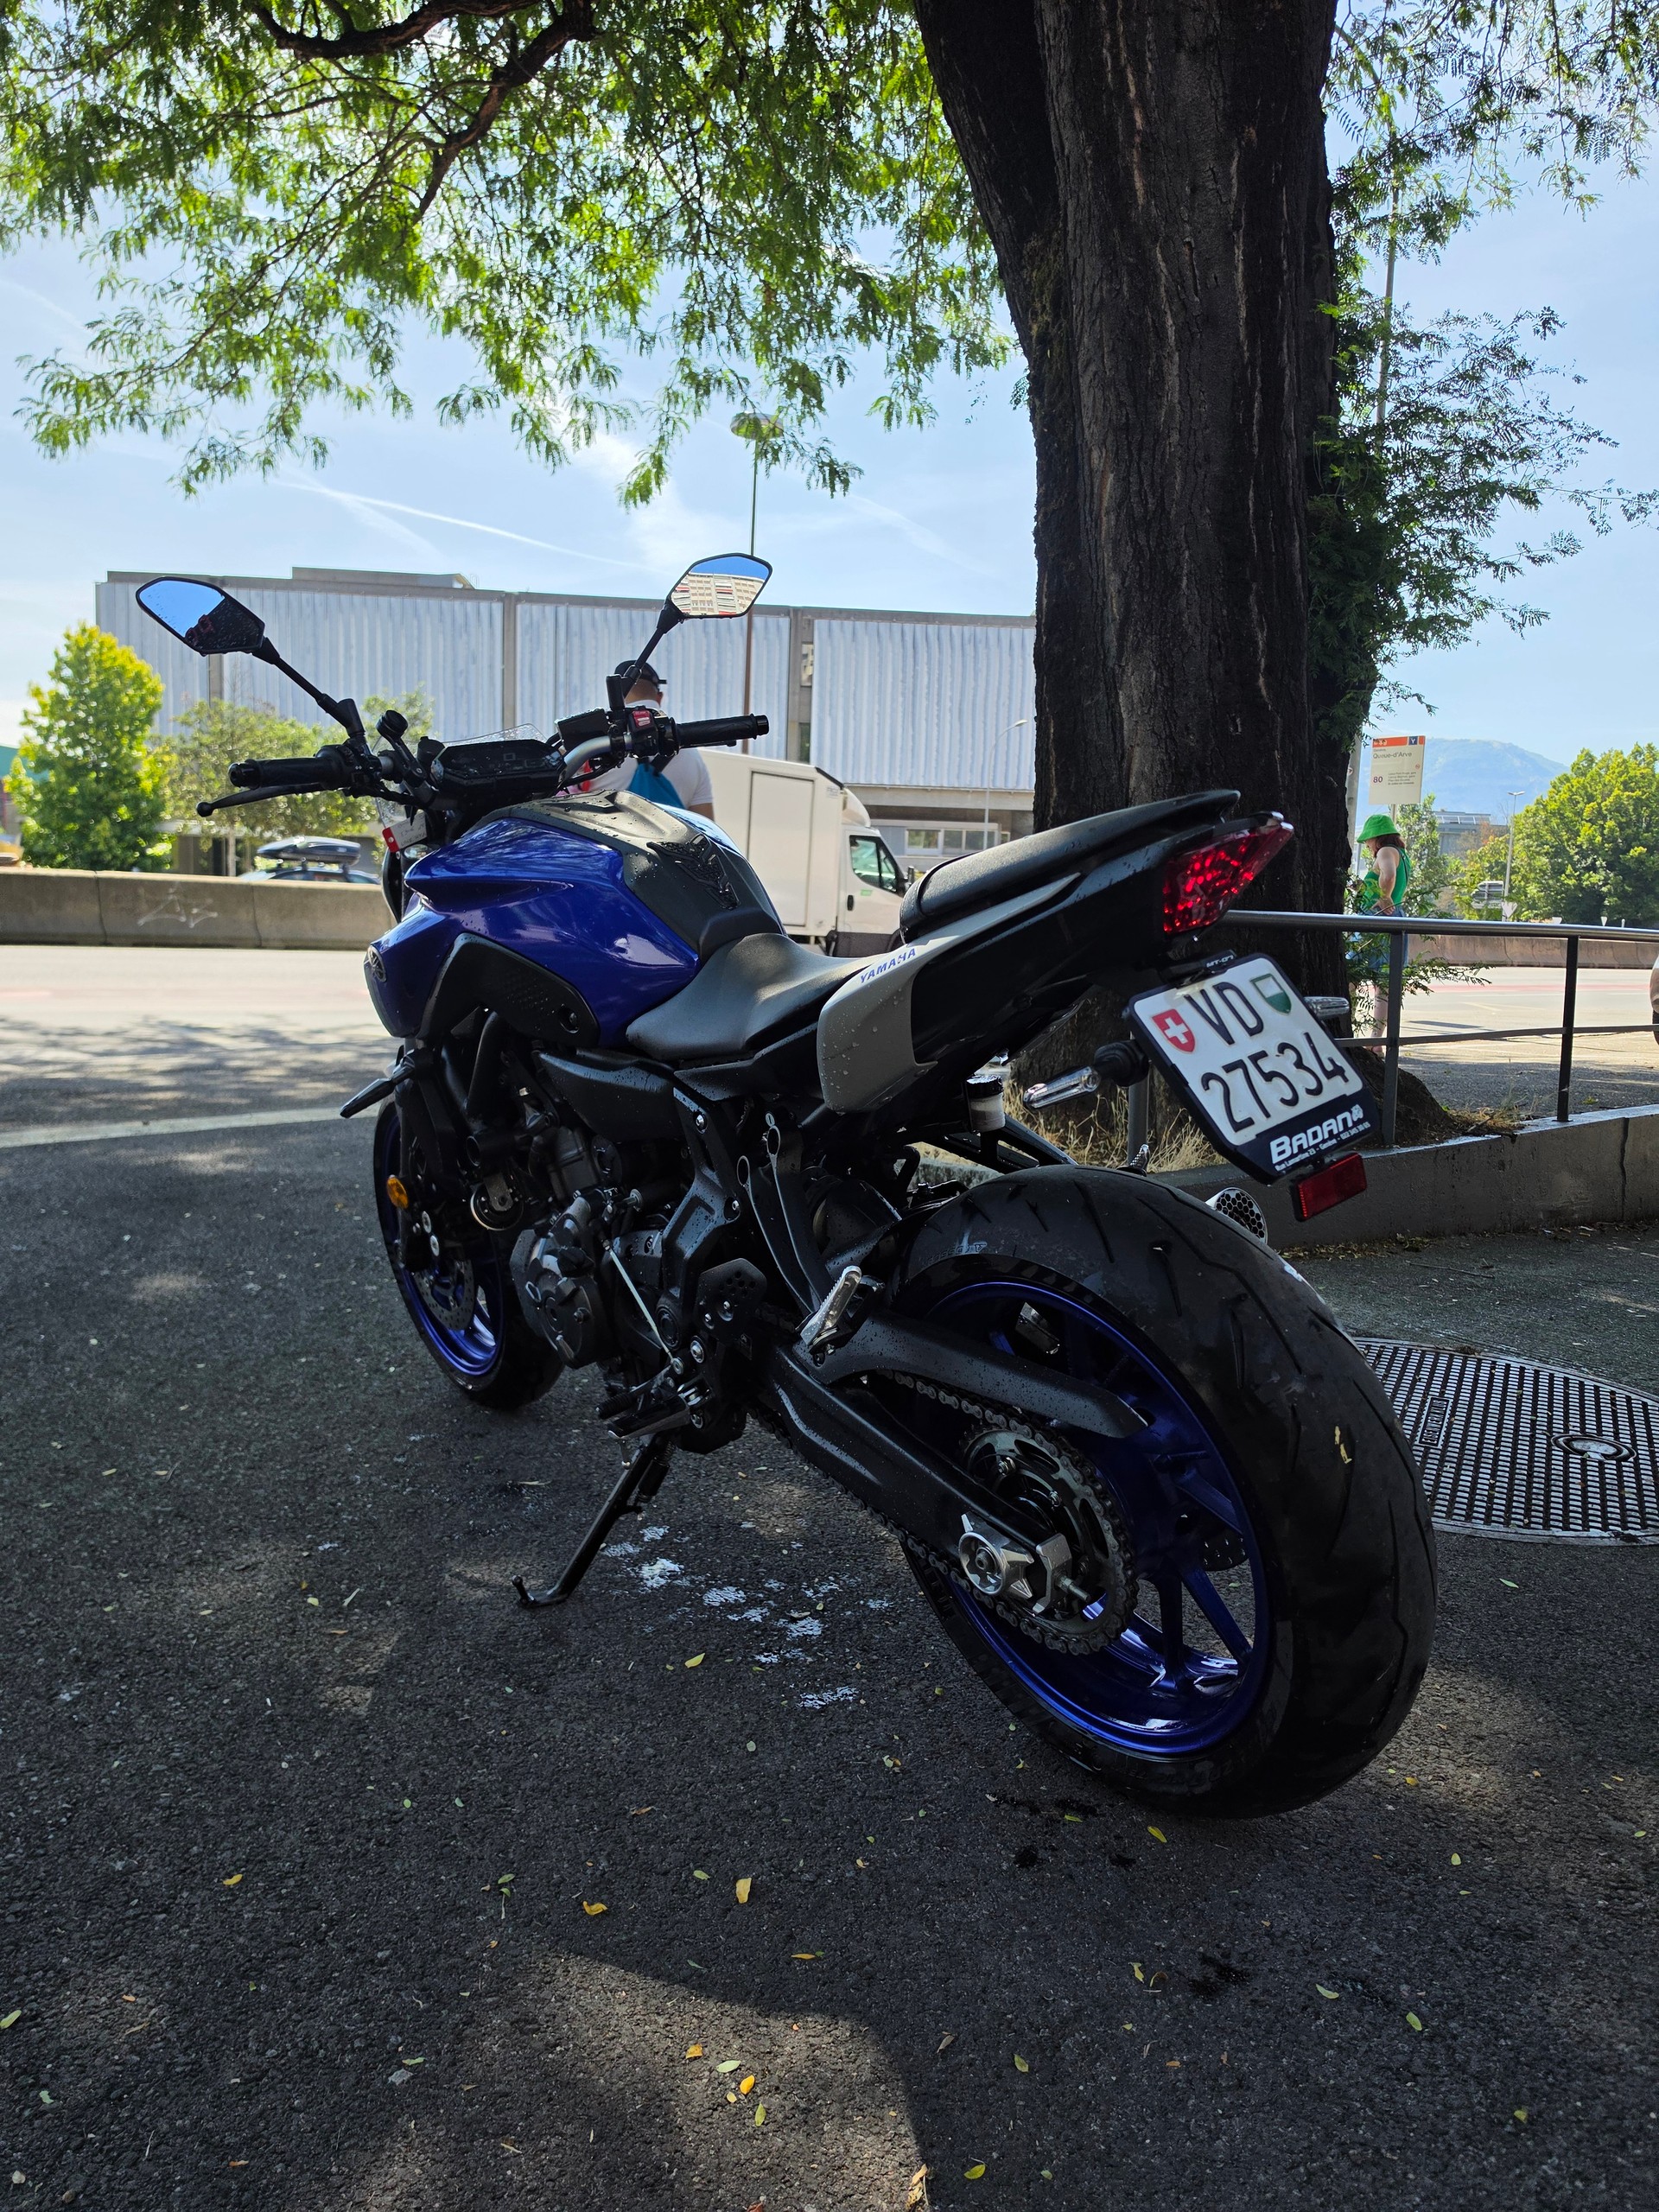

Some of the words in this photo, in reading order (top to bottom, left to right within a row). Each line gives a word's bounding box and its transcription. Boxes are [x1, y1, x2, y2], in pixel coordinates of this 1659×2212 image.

[860, 948, 916, 983] YAMAHA
[1184, 982, 1264, 1046] VD
[1201, 1032, 1350, 1133] 27534
